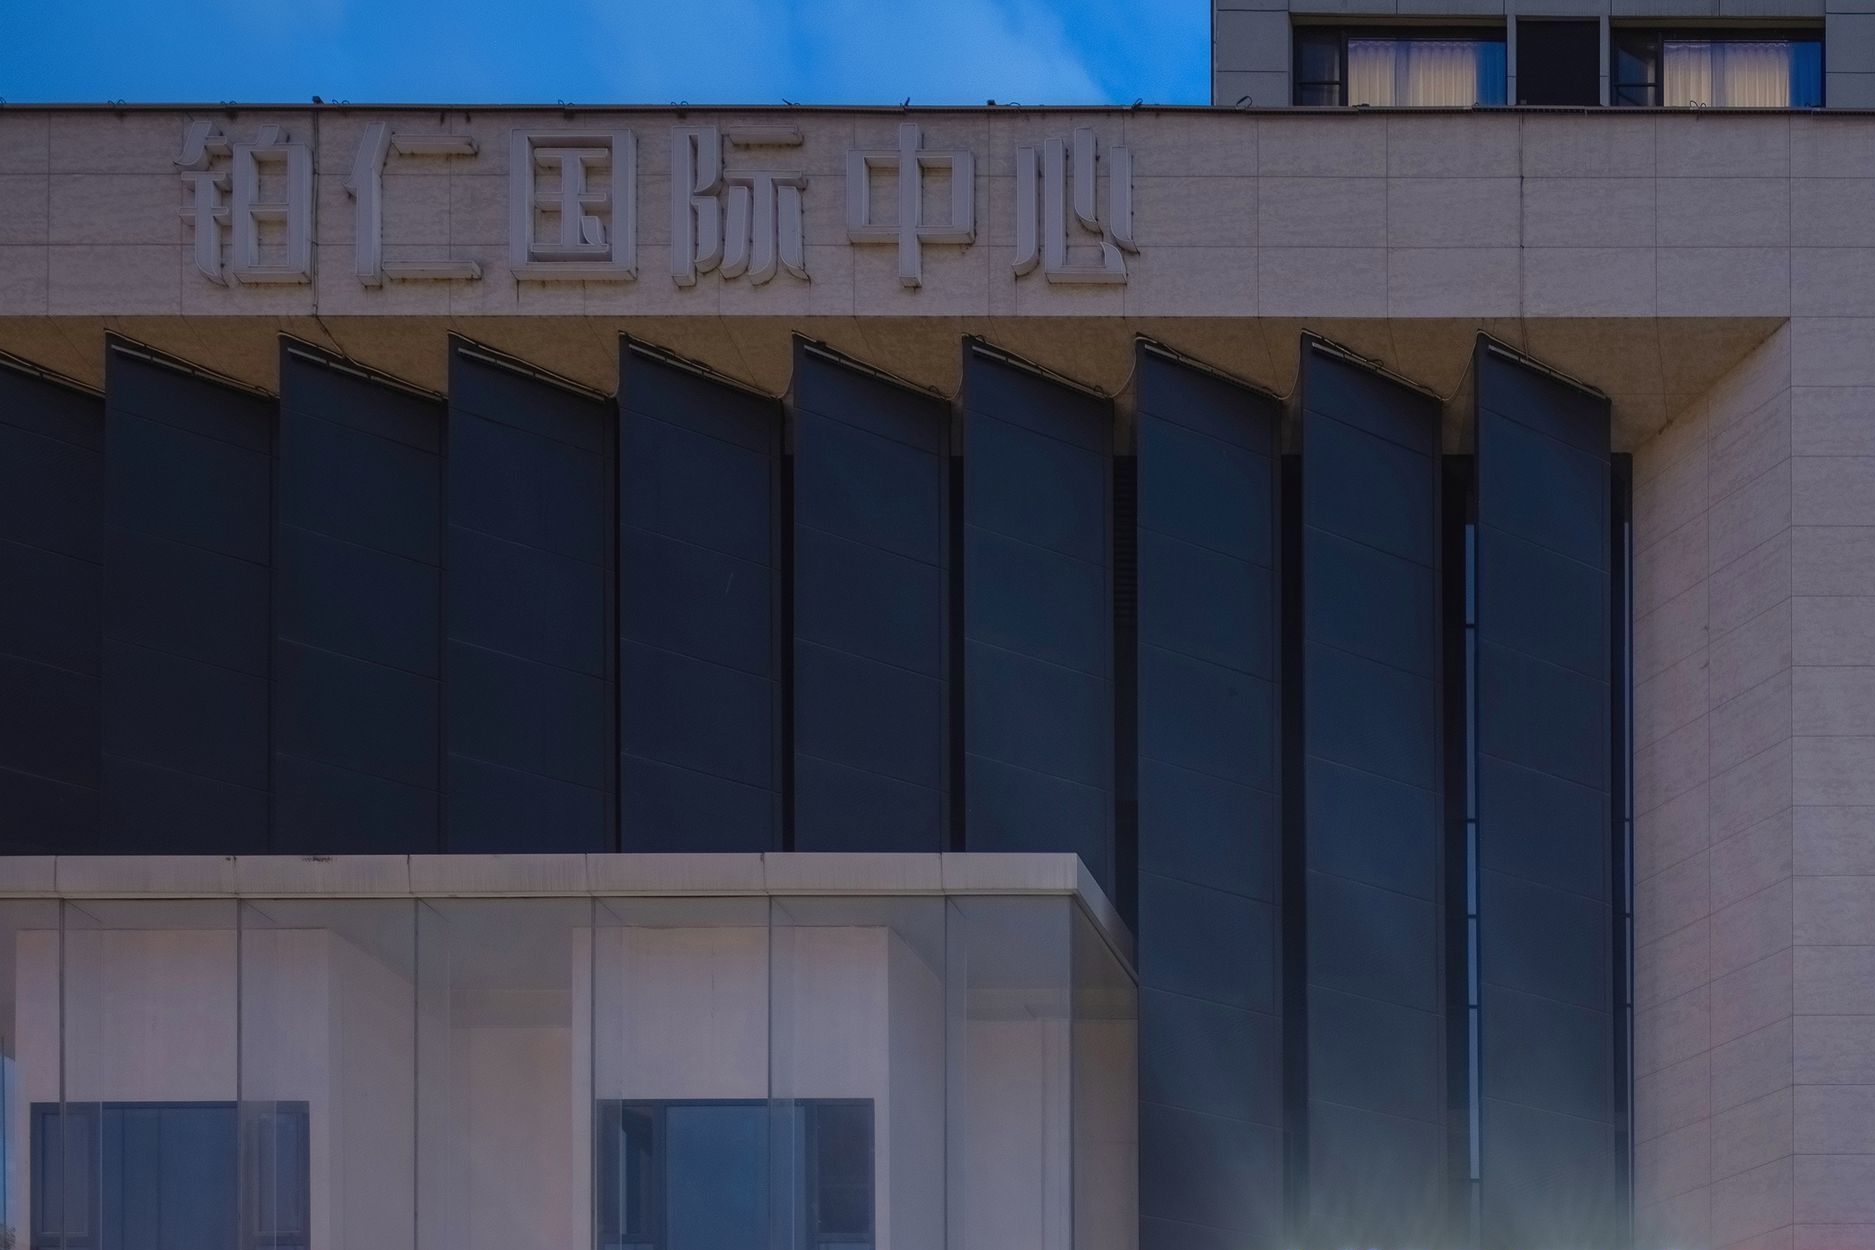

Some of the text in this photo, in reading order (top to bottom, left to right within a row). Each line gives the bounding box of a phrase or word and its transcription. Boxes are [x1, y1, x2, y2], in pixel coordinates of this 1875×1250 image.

[178, 119, 1141, 290] 铂仁国际中心
